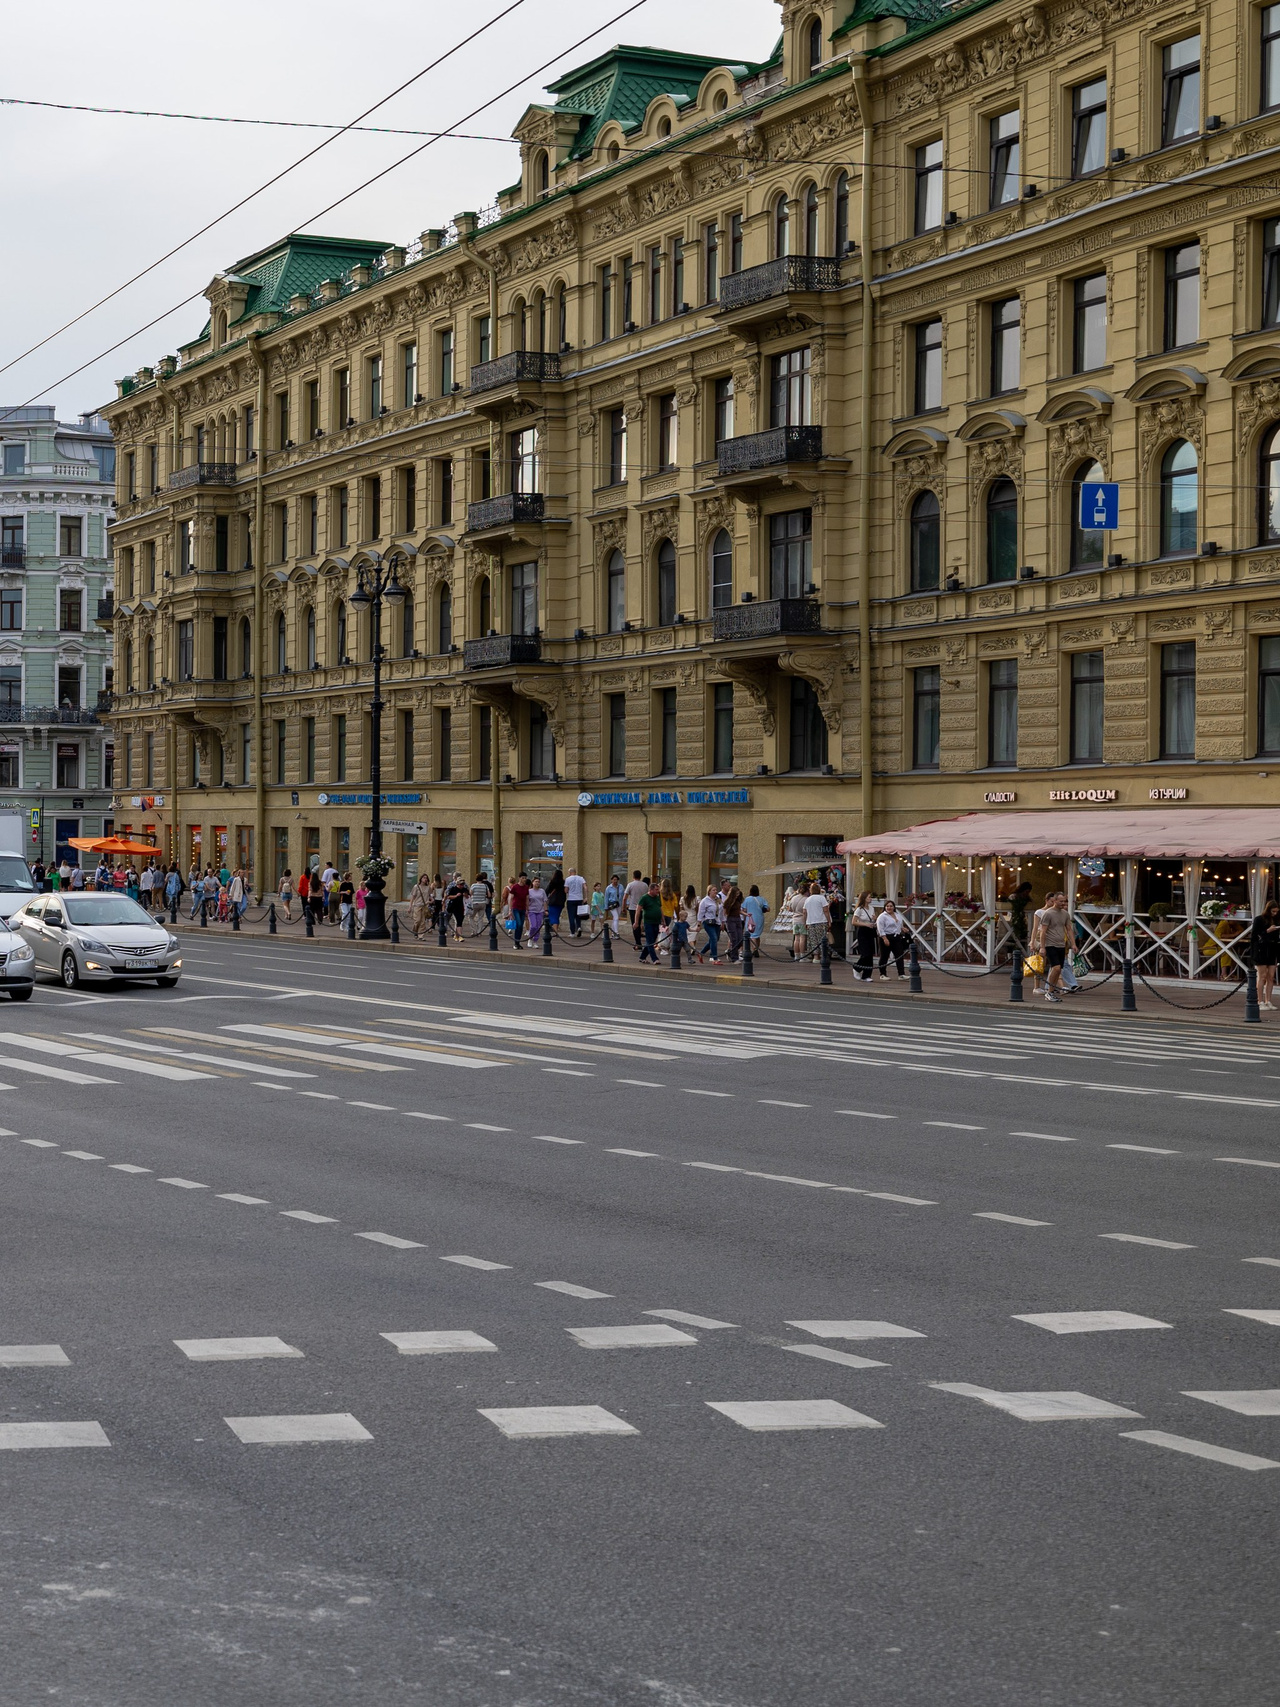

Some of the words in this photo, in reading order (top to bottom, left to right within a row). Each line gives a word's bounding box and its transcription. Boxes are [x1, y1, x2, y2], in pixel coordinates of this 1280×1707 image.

[594, 792, 641, 804] КНИЖНАЯ
[647, 792, 682, 804] ЛАВКА
[687, 788, 750, 803] ПИСАТЕЛЕЙ
[984, 792, 1015, 802] СЛАДОСТИ
[1049, 791, 1070, 800] Elit
[1072, 790, 1116, 802] LOQUM
[1149, 789, 1159, 799] ИЗ
[1160, 788, 1186, 799] ТУРЦИИ
